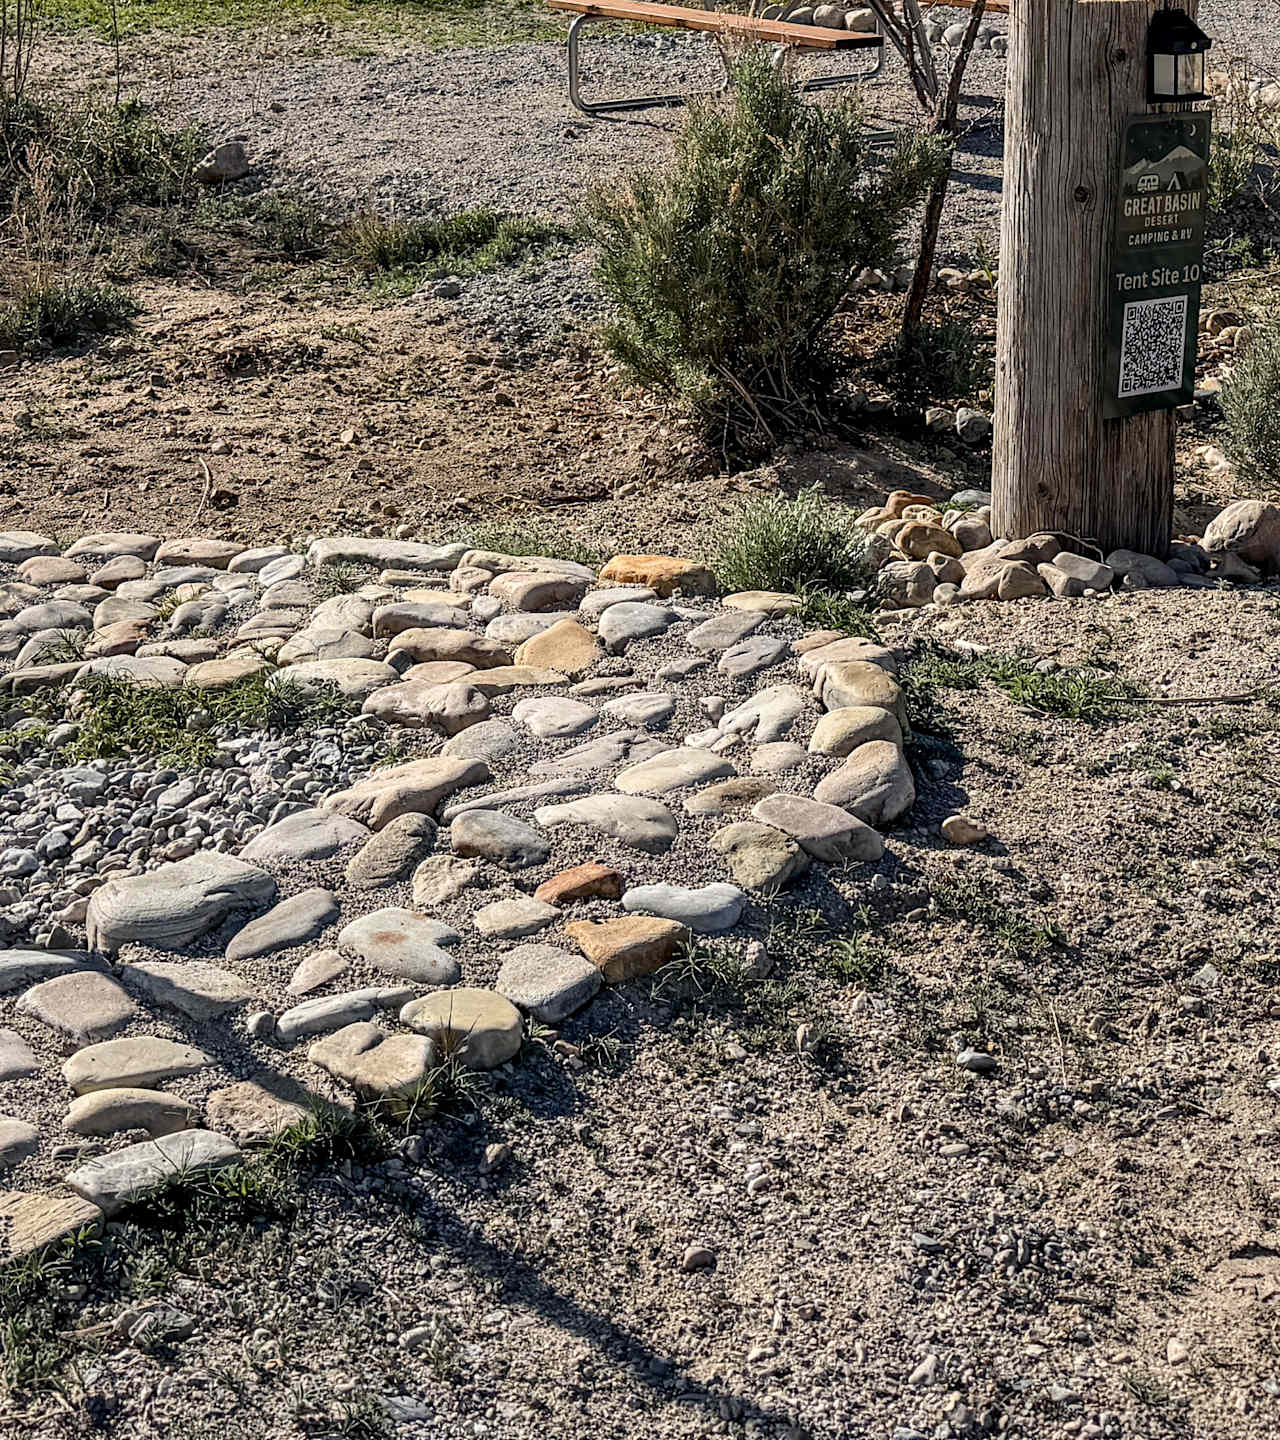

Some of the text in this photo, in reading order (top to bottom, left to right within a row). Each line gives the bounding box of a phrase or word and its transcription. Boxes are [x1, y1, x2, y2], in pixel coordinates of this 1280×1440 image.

[1124, 192, 1200, 216] GREAT BASIN
[1144, 214, 1179, 227] DESERT
[1128, 228, 1193, 246] CAMPING & RV
[1116, 264, 1200, 291] Tent Site 10
